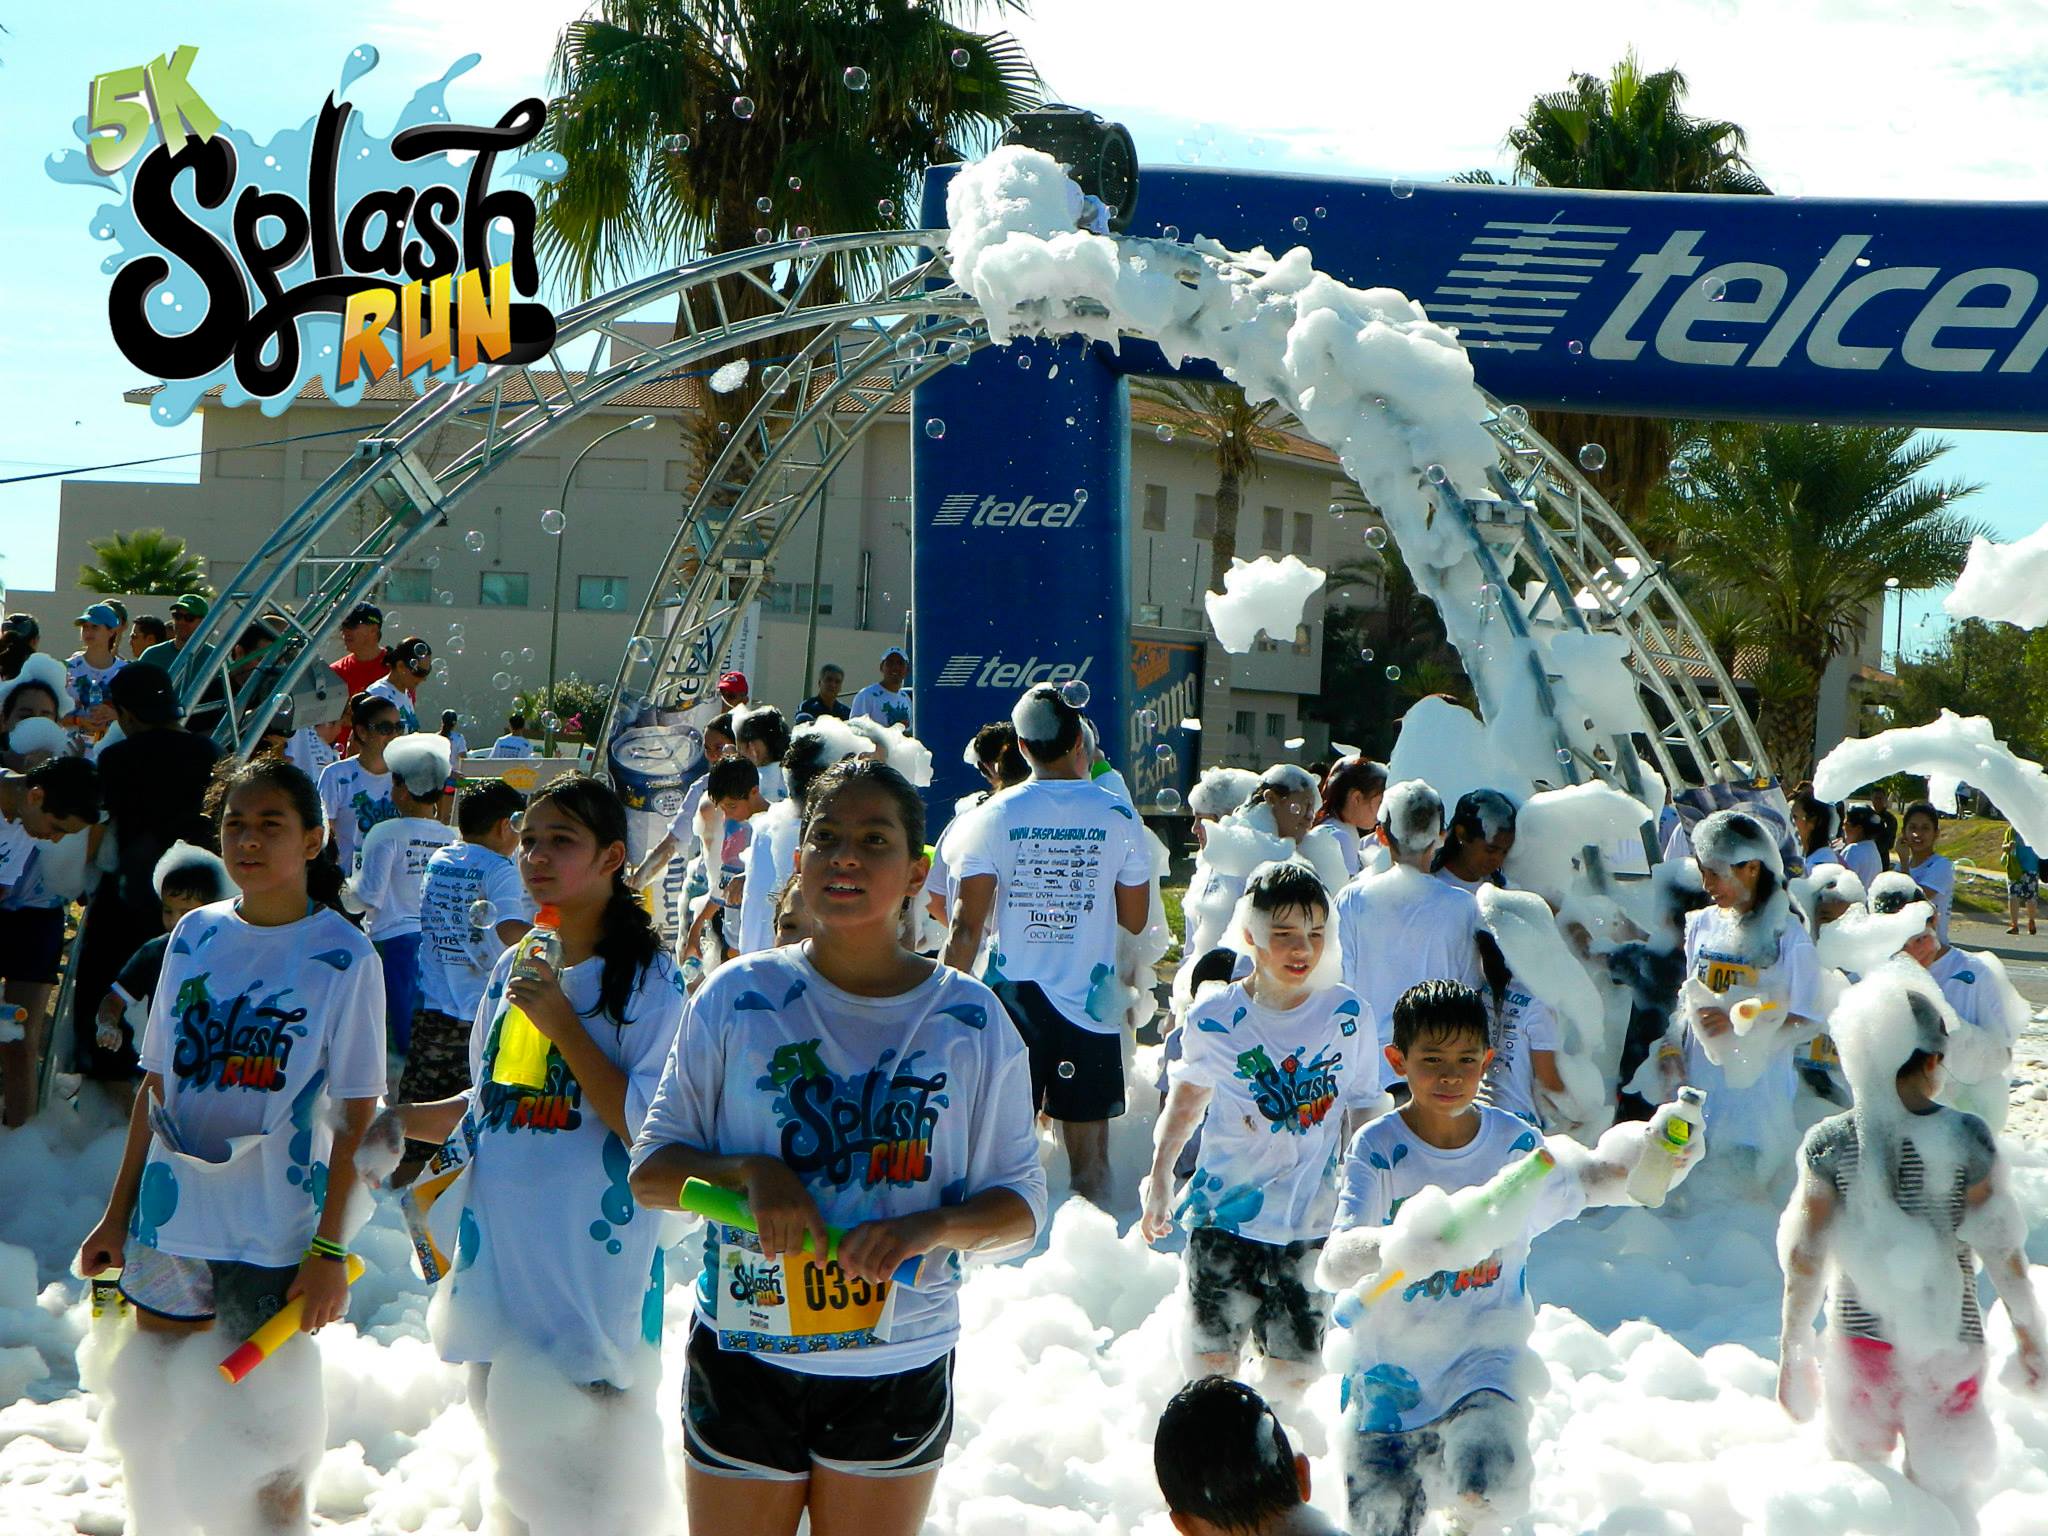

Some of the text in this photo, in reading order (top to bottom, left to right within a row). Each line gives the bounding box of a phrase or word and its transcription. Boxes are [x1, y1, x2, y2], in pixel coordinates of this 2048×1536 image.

[972, 494, 1085, 528] telcel
[976, 655, 1094, 689] telcel
[1028, 909, 1078, 923] Torreón
[173, 991, 307, 1085] Splash
[221, 1055, 282, 1088] RUN
[512, 1095, 574, 1129] RUN
[781, 1066, 947, 1184] Splash
[866, 1138, 929, 1184] RUN
[730, 1262, 785, 1305] Splash
